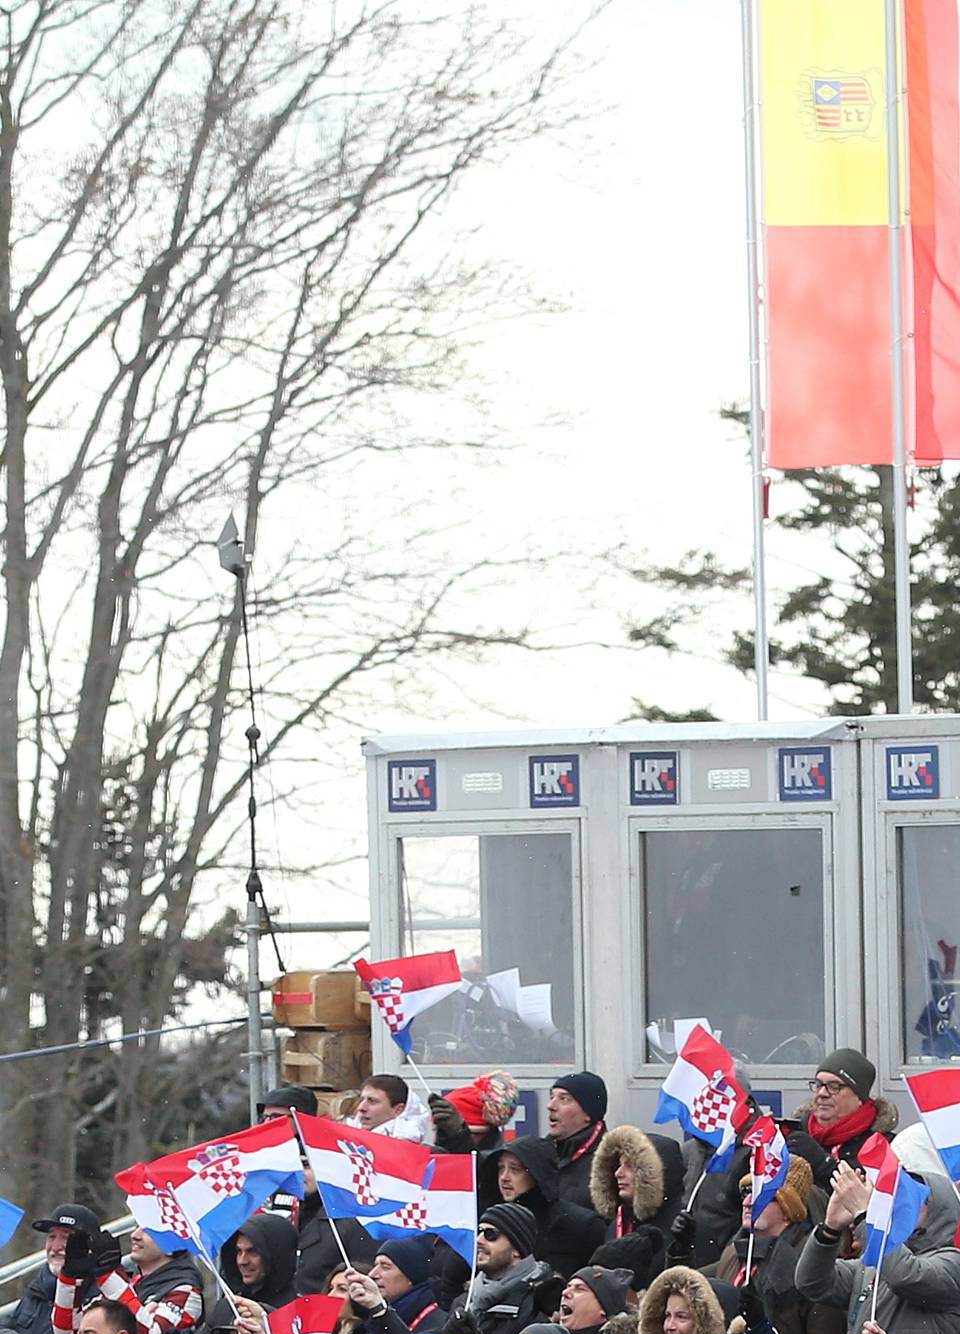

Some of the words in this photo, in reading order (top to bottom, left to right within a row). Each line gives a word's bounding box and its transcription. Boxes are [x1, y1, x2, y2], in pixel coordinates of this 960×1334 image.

[392, 767, 431, 798] HRT
[534, 762, 574, 794] HRT
[635, 759, 674, 791] HRT
[784, 754, 825, 787] HRT
[890, 753, 932, 787] HRT
